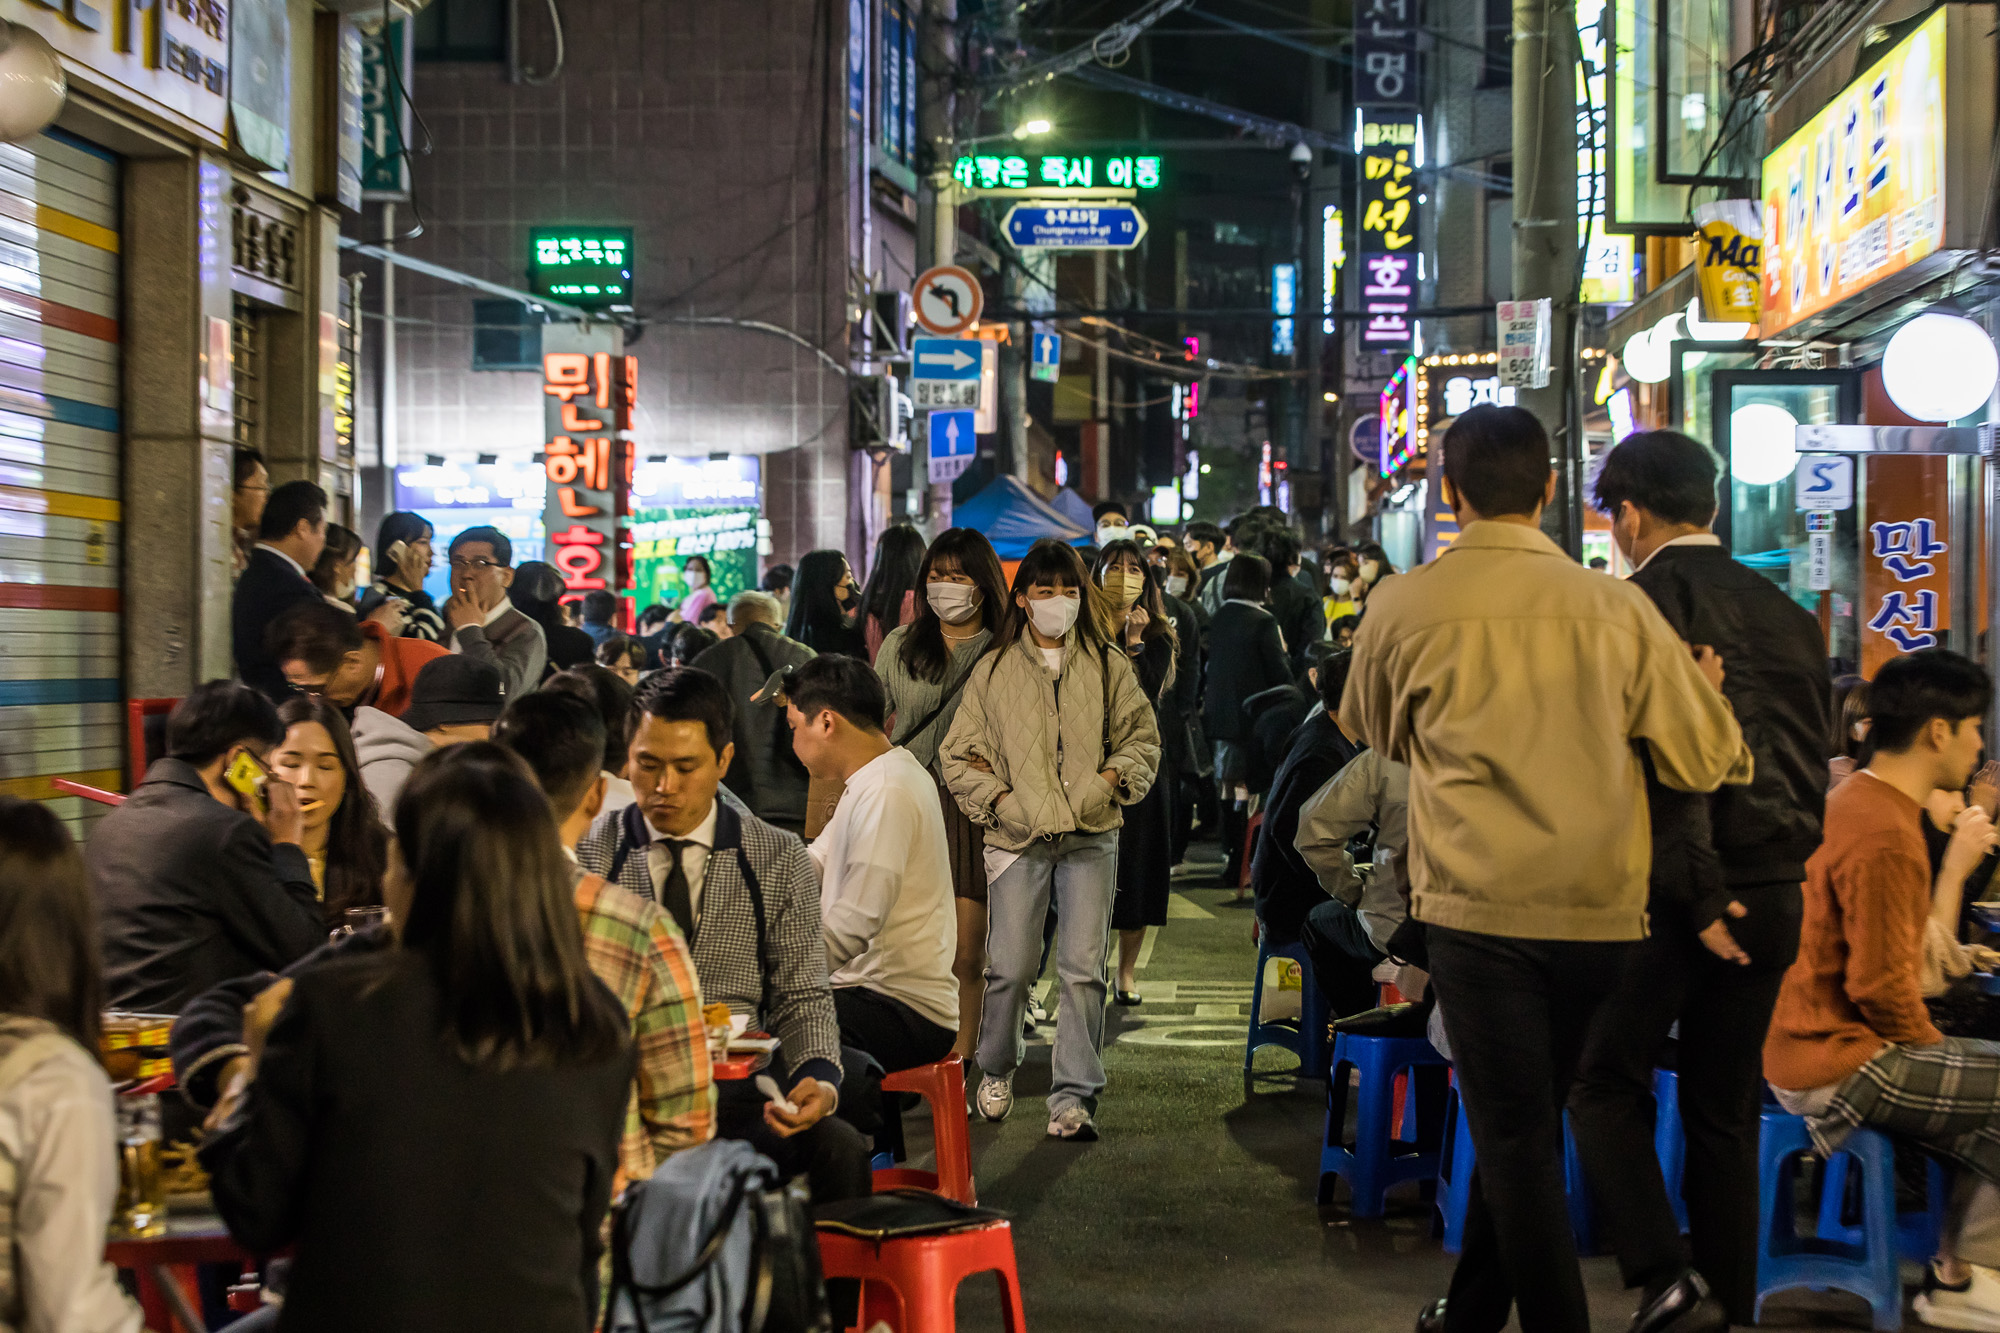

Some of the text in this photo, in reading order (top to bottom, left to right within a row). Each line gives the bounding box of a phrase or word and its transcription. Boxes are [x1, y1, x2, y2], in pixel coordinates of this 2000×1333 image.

[1363, 122, 1416, 147] 을지로
[1040, 155, 1093, 188] 즉시
[1363, 148, 1413, 250] 만선
[1121, 220, 1134, 234] 12
[1703, 234, 1762, 268] Ma
[1365, 254, 1412, 341] 호프
[543, 352, 610, 606] 뮌헨호
[1867, 517, 1949, 652] 만선
